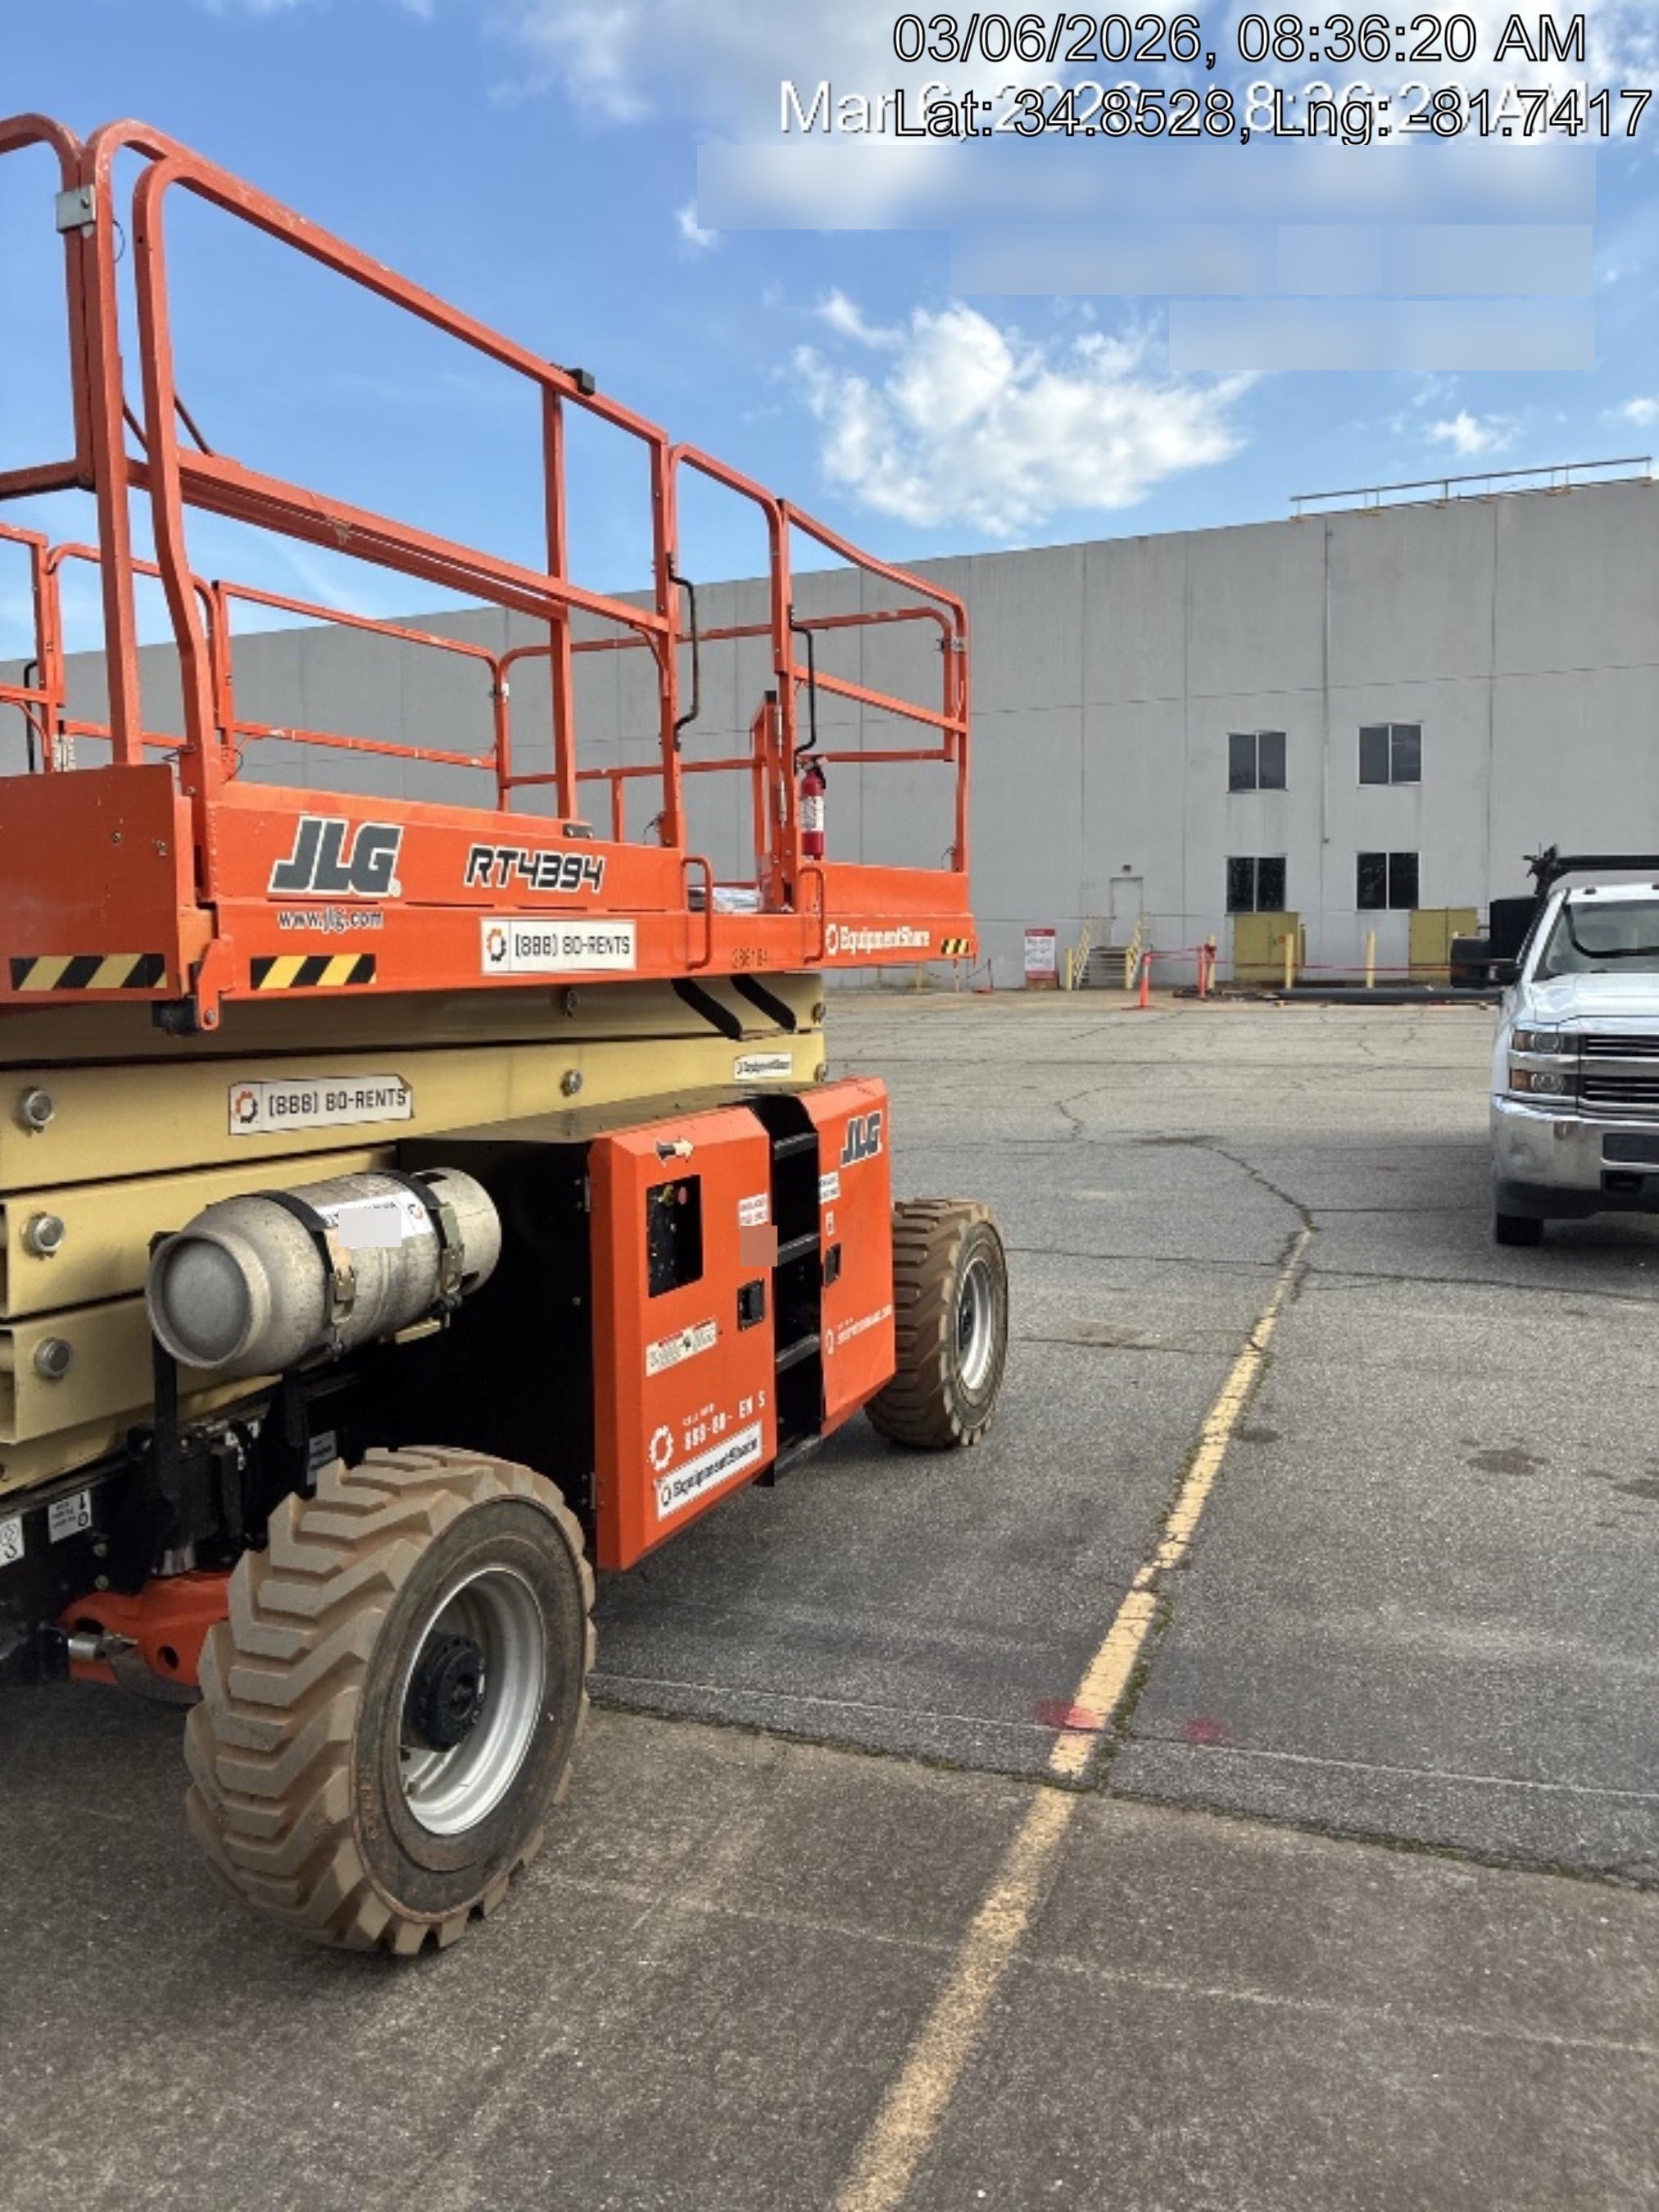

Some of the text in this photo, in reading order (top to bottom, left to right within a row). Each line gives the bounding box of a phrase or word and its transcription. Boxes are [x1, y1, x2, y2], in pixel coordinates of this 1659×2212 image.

[267, 814, 404, 898] JLG
[464, 842, 606, 895] RT4394
[278, 905, 384, 935] www.jlg.com
[840, 1109, 882, 1169] JLG
